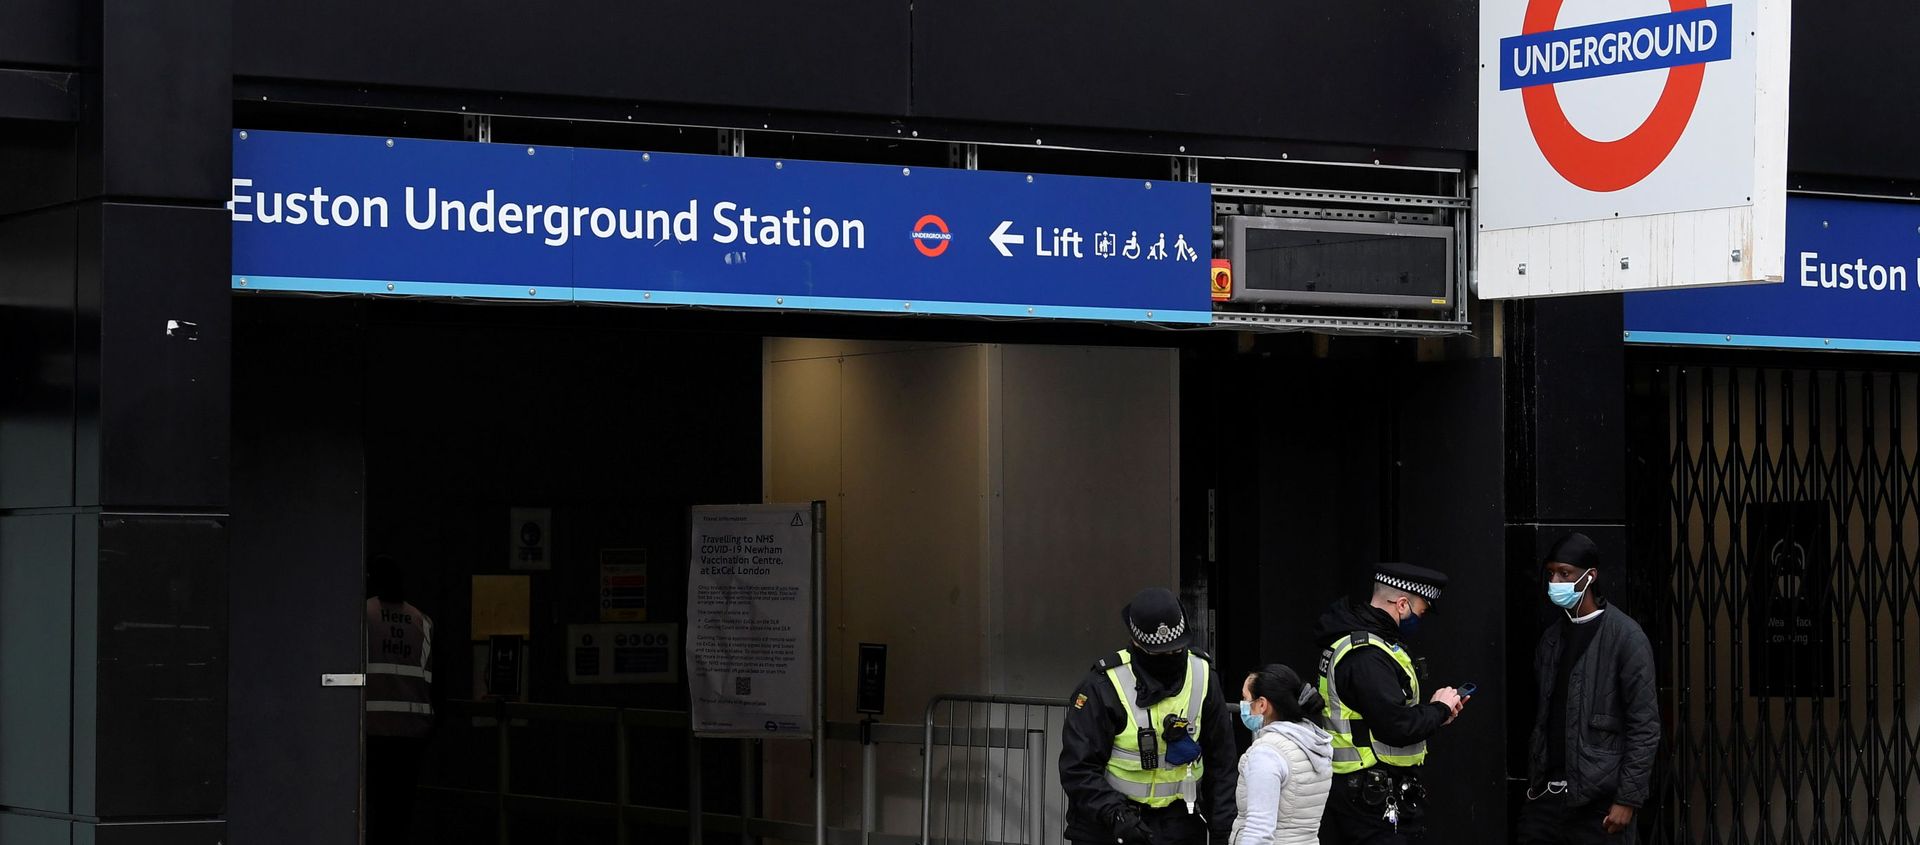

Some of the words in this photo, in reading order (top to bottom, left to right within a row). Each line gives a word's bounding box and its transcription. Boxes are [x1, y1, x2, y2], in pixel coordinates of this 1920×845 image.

[1513, 19, 1718, 77] UNDERGROUND
[228, 178, 388, 227] Euston
[405, 186, 698, 248] Underground
[712, 201, 865, 249] Station
[911, 232, 952, 240] UNDERGROUND
[1036, 227, 1084, 259] Lift
[1800, 251, 1907, 292] Euston
[702, 535, 741, 545] Travelling
[744, 535, 753, 543] to
[756, 535, 774, 543] NHS
[701, 545, 742, 554] COVID-19
[744, 545, 783, 554] Newham
[701, 556, 749, 565] Vaccination
[700, 567, 709, 575] at
[738, 567, 770, 575] London
[381, 608, 412, 624] Here
[391, 625, 404, 639] to
[382, 639, 412, 659] Help
